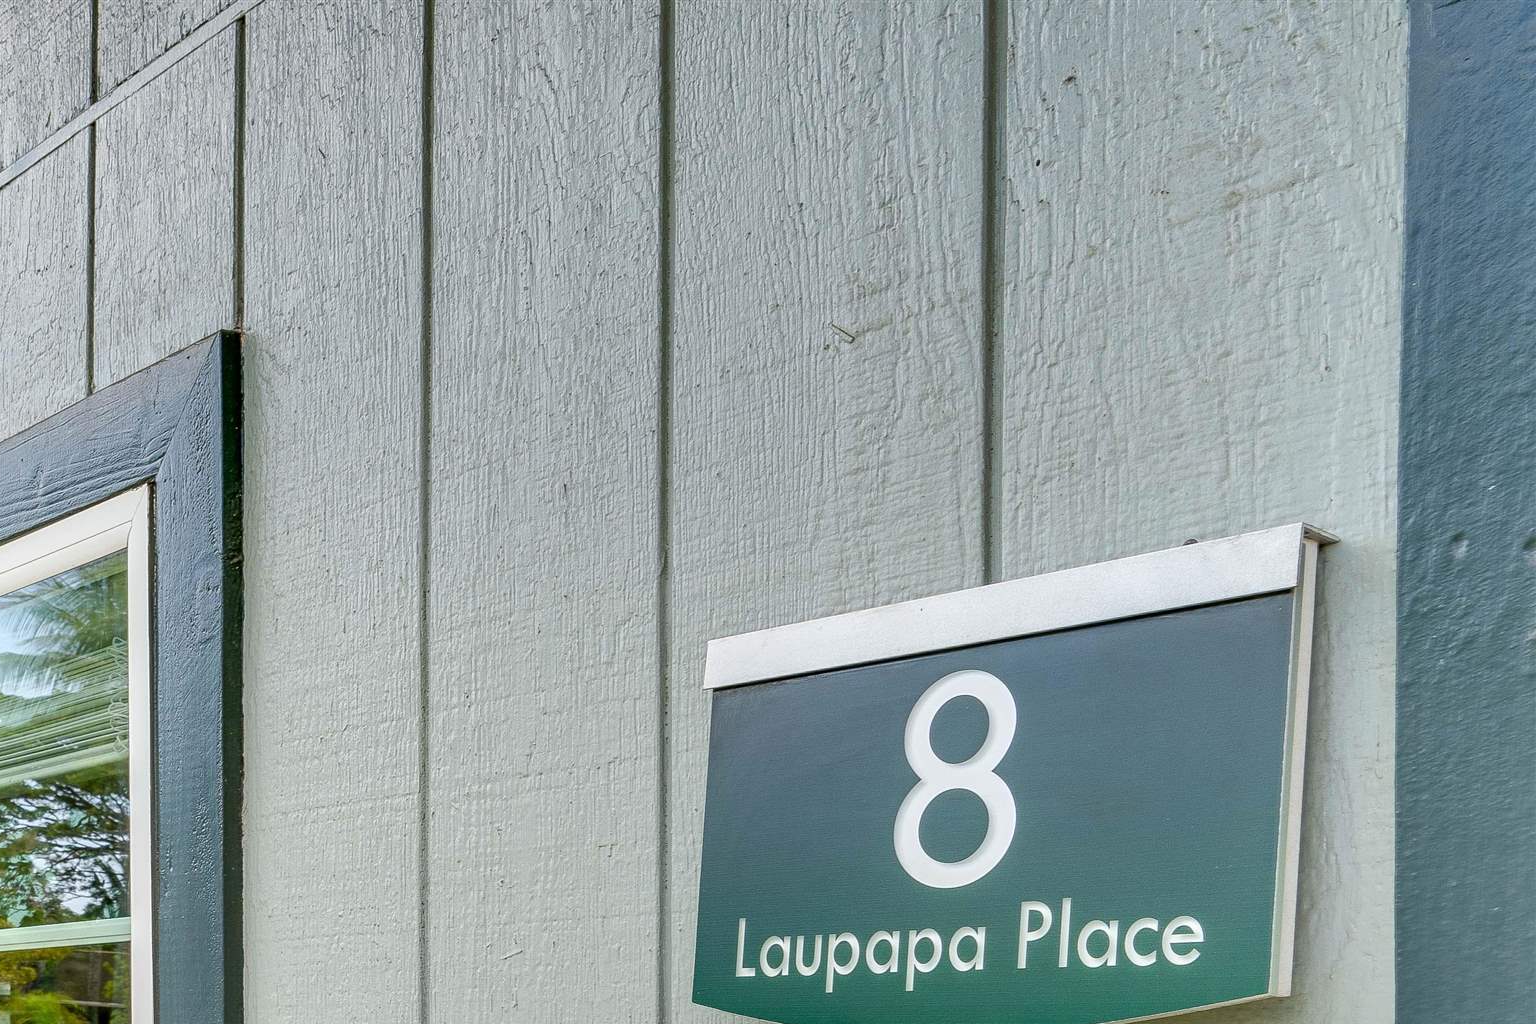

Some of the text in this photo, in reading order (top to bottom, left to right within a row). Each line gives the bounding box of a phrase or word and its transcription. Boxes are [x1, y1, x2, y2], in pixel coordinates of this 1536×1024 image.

[893, 669, 1018, 889] 8
[735, 897, 1205, 993] Laupapa Place
